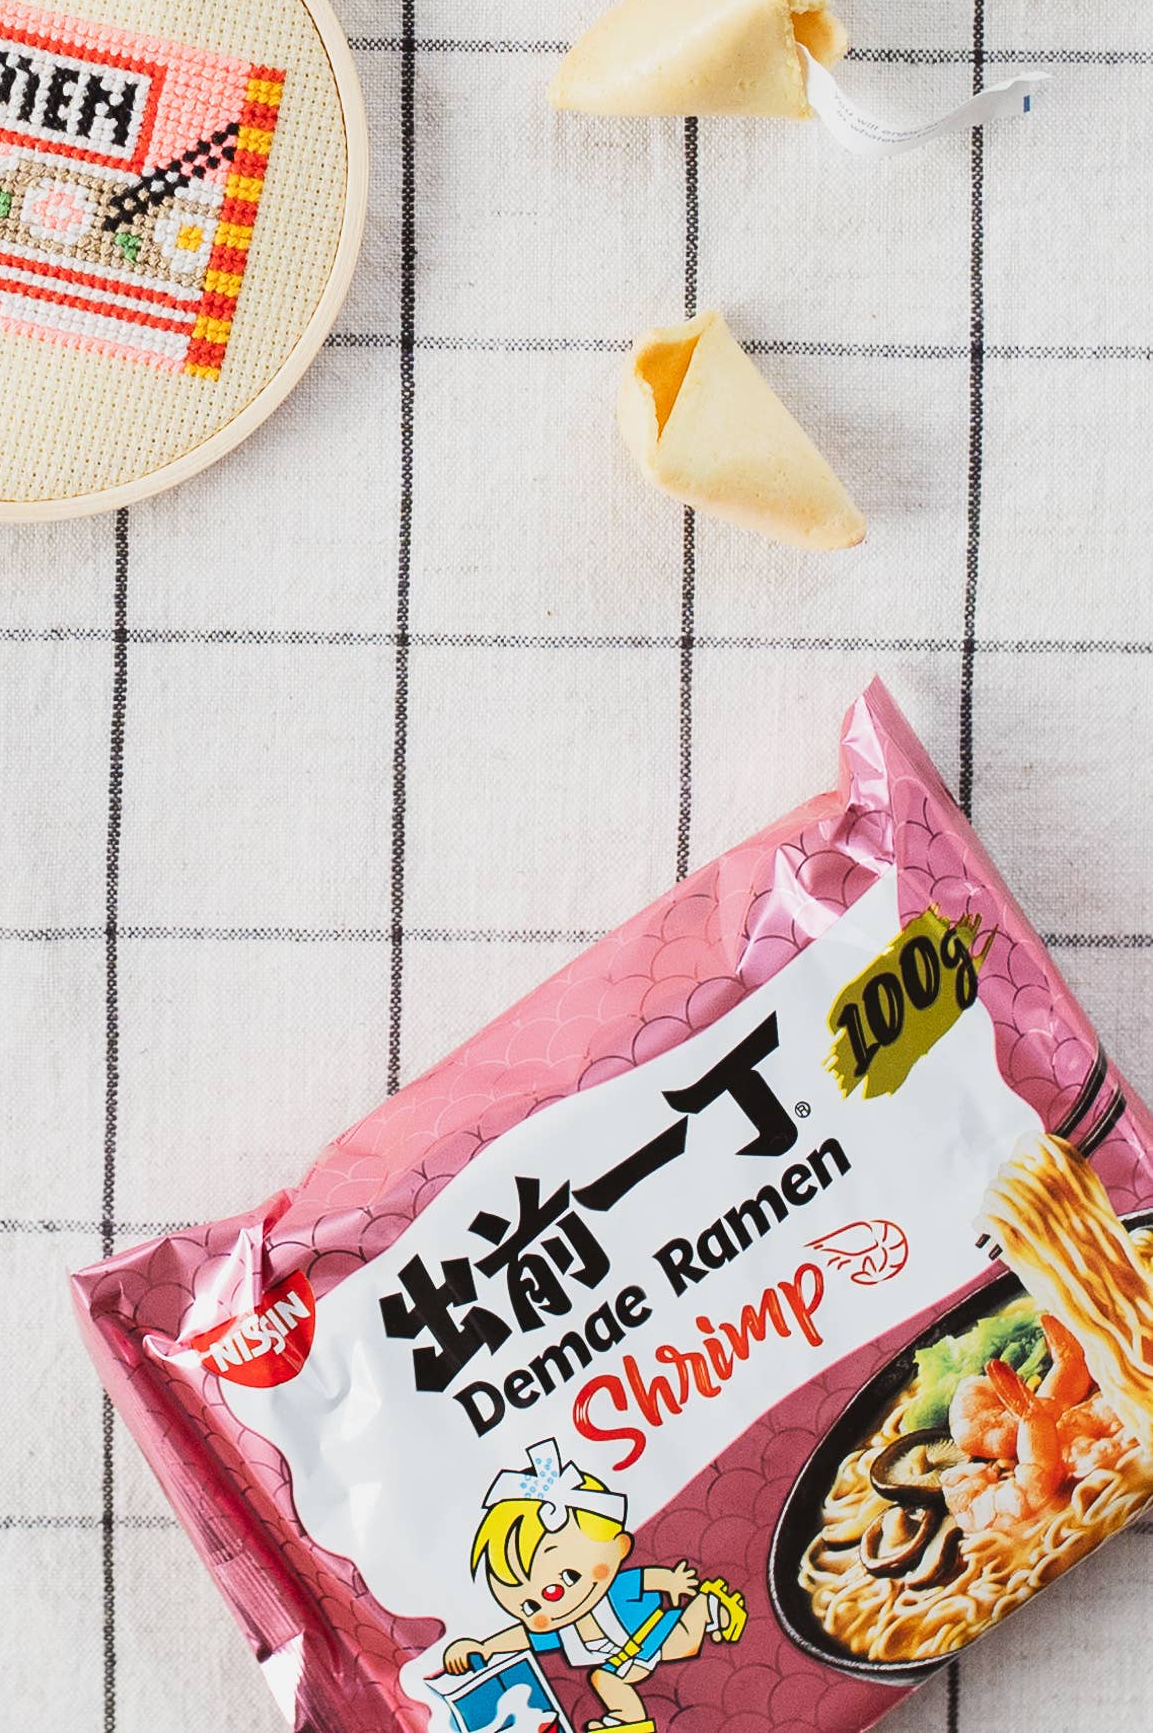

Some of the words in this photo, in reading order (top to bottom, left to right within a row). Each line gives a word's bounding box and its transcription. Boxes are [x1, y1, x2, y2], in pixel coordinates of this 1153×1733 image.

[836, 928, 979, 1078] 100g
[379, 1009, 799, 1393] 出前一丁
[453, 1284, 653, 1438] Demae
[652, 1137, 852, 1298] Ramen
[208, 1290, 311, 1373] NISSIN
[572, 1262, 825, 1472] Shrimp
